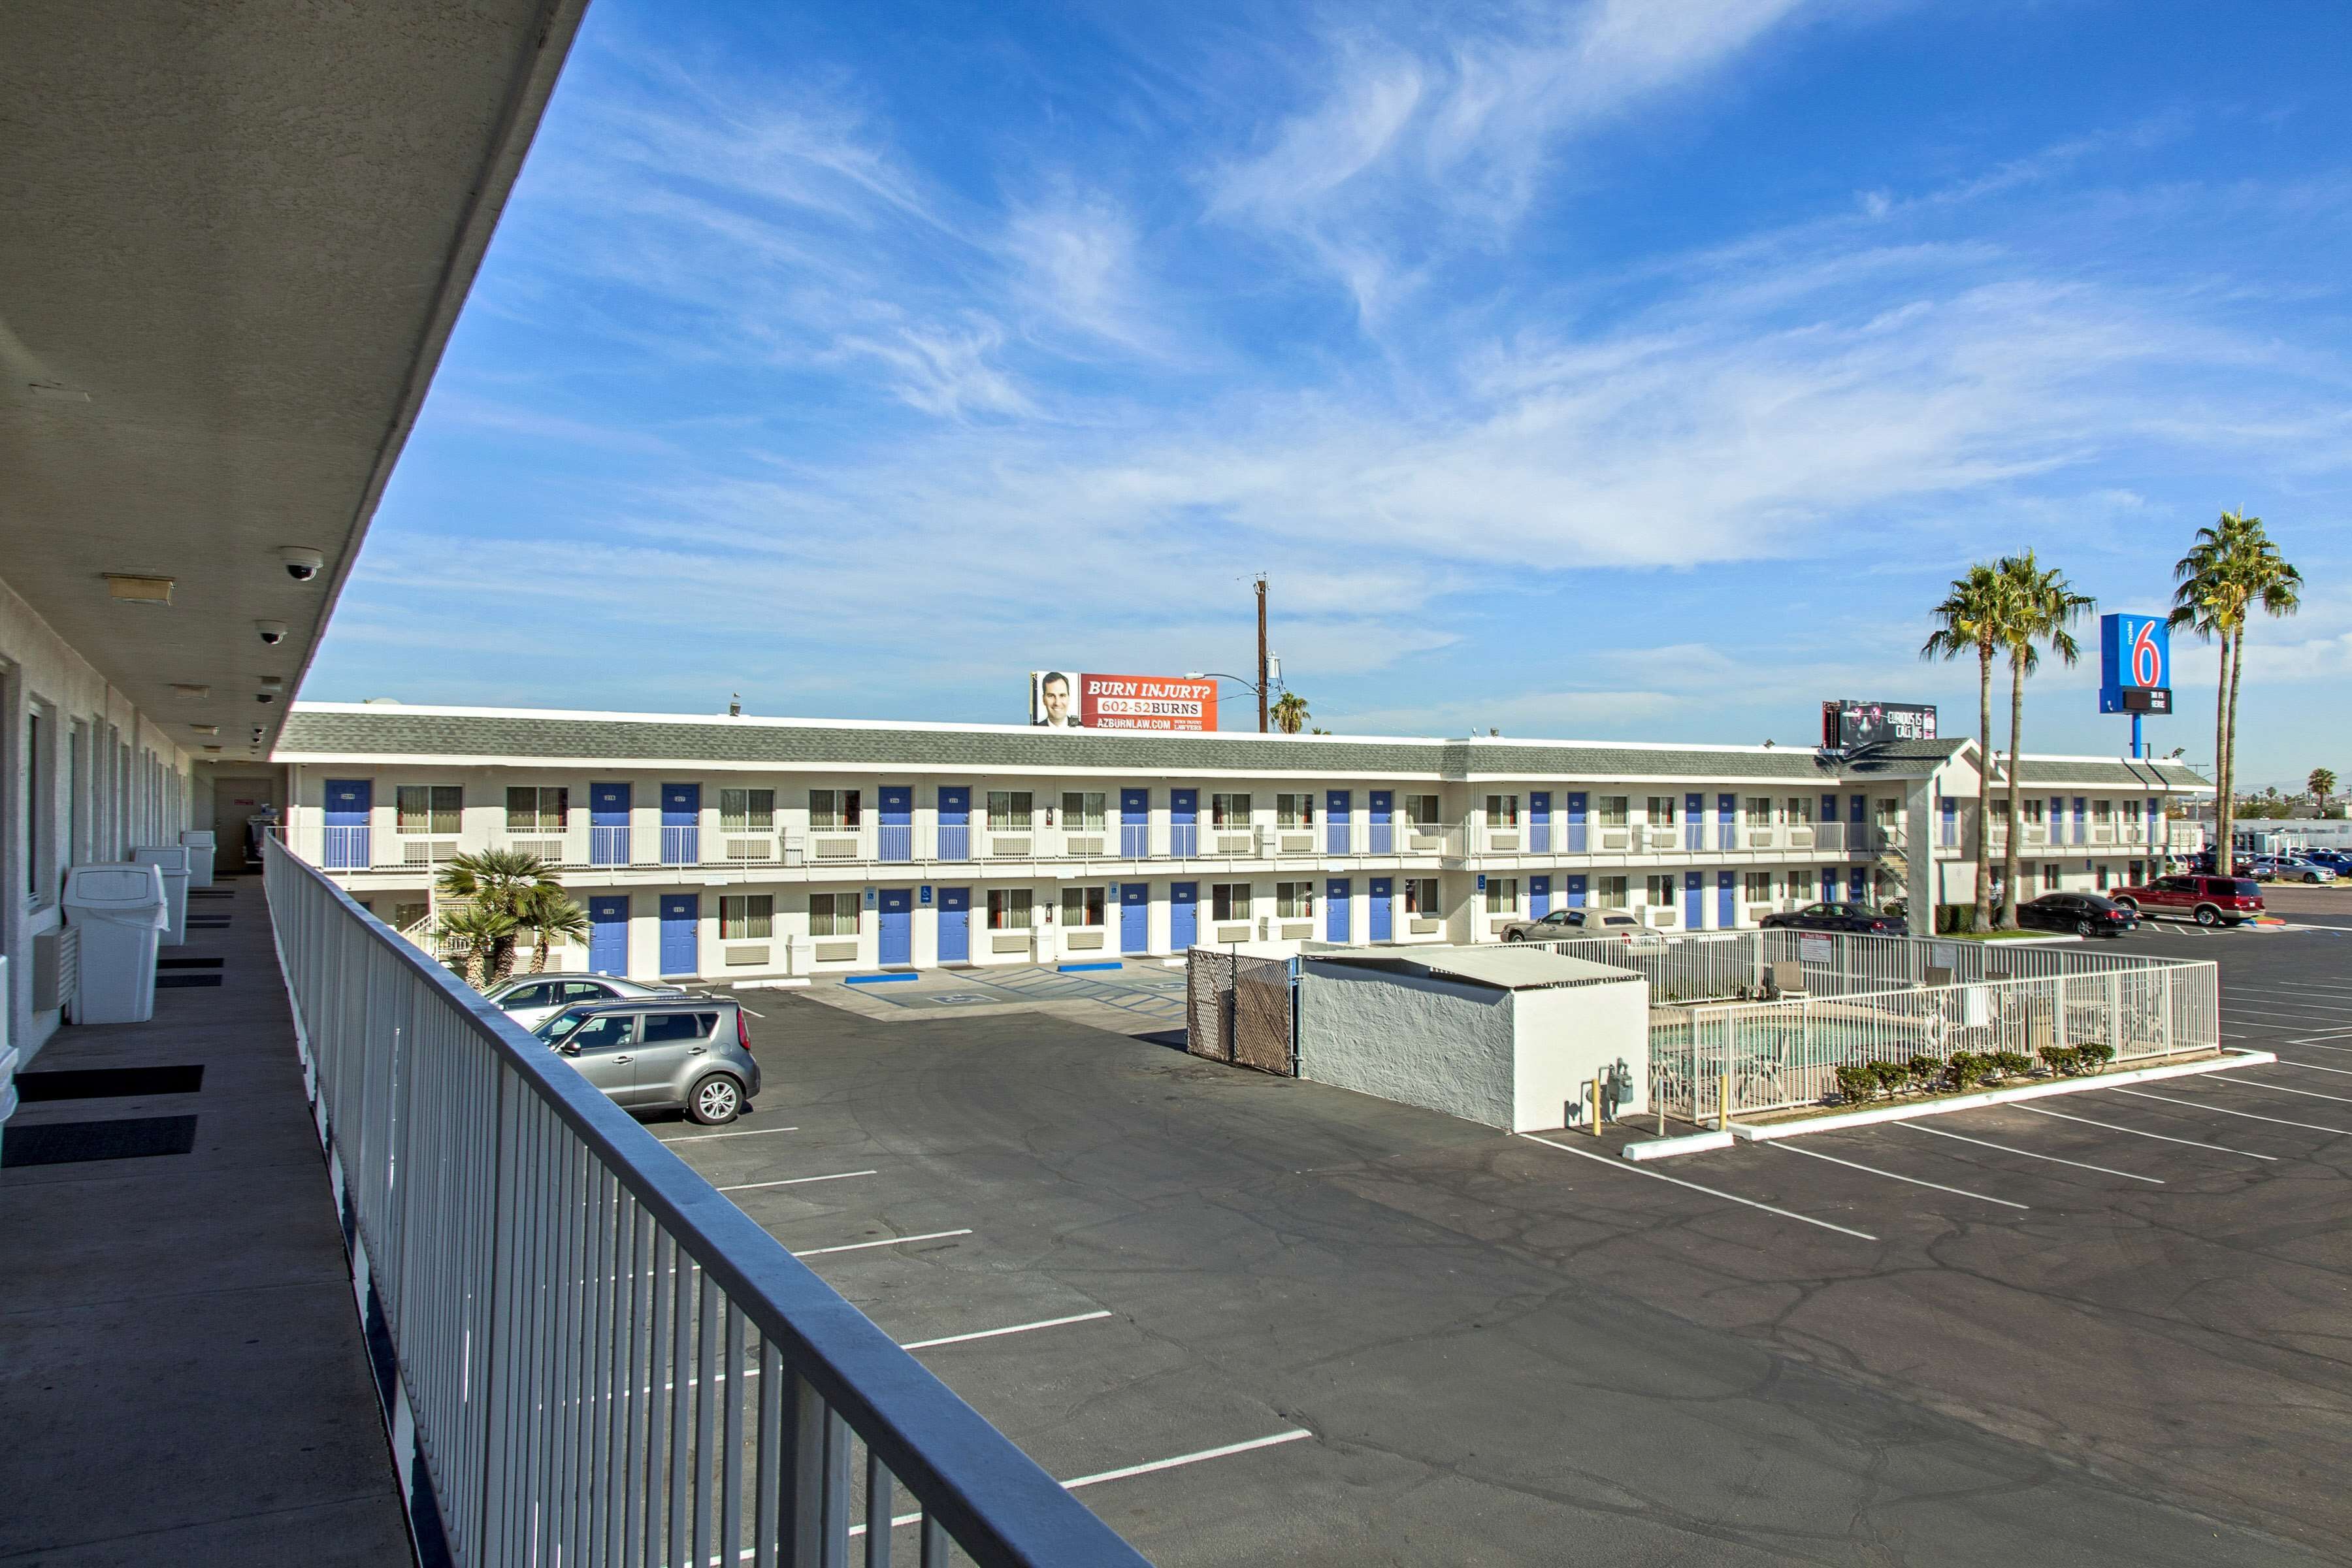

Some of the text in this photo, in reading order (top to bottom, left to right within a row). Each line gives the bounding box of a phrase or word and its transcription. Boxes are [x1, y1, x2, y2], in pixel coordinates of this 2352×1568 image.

[2132, 620, 2162, 688] 6
[1088, 681, 1211, 699] BURN INJURY?
[1102, 700, 1198, 715] 602-52BURNS
[1098, 718, 1170, 730] AZBURNLAW.COM
[1887, 711, 1915, 725] CURIOUS
[1915, 713, 1922, 725] IS
